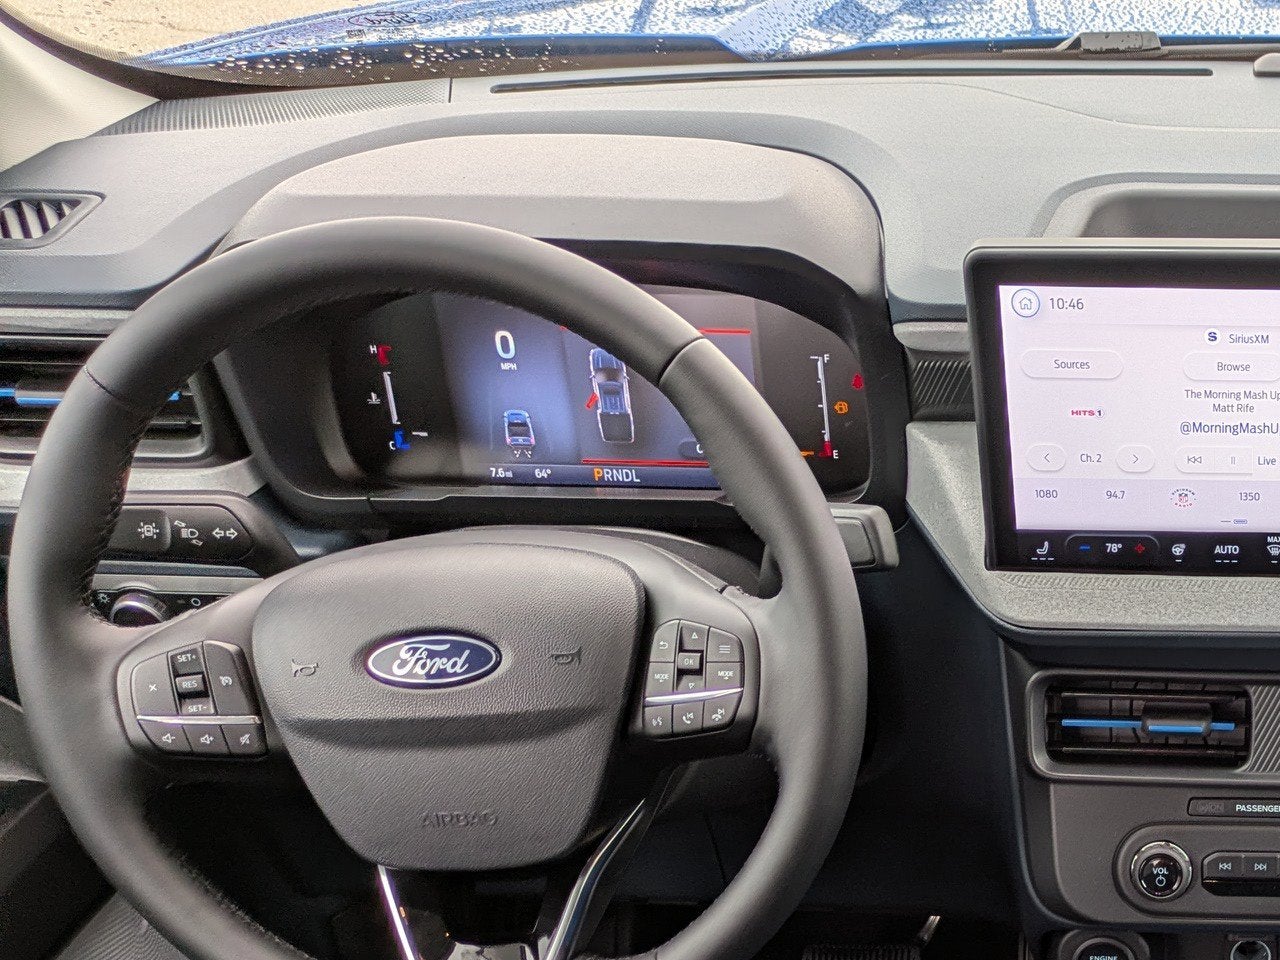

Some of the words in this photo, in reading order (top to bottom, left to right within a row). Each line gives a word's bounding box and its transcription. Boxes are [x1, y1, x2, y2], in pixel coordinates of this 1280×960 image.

[1049, 298, 1084, 310] 10:46
[494, 330, 516, 359] 0
[1229, 334, 1269, 345] SiriusXM
[500, 362, 517, 371] MPH
[1053, 359, 1090, 370] Sources
[1217, 362, 1251, 372] Browse
[1184, 390, 1201, 399] The
[1204, 390, 1242, 402] Morning
[1245, 390, 1267, 400] Mash
[1071, 409, 1095, 417] HITS
[1212, 403, 1234, 413] Matt
[1236, 403, 1255, 413] Rife
[1080, 453, 1094, 463] Ch.
[1096, 454, 1102, 463] 2
[1258, 456, 1277, 466] Live
[1035, 489, 1058, 499] 1080
[1106, 490, 1125, 500] 94.7
[1238, 492, 1261, 502] 1350
[1105, 543, 1122, 553] 78°
[1214, 545, 1239, 554] AUTO
[392, 643, 471, 676] Ford
[654, 672, 670, 680] MODE
[182, 680, 197, 689] RES
[1152, 867, 1169, 875] VOL
